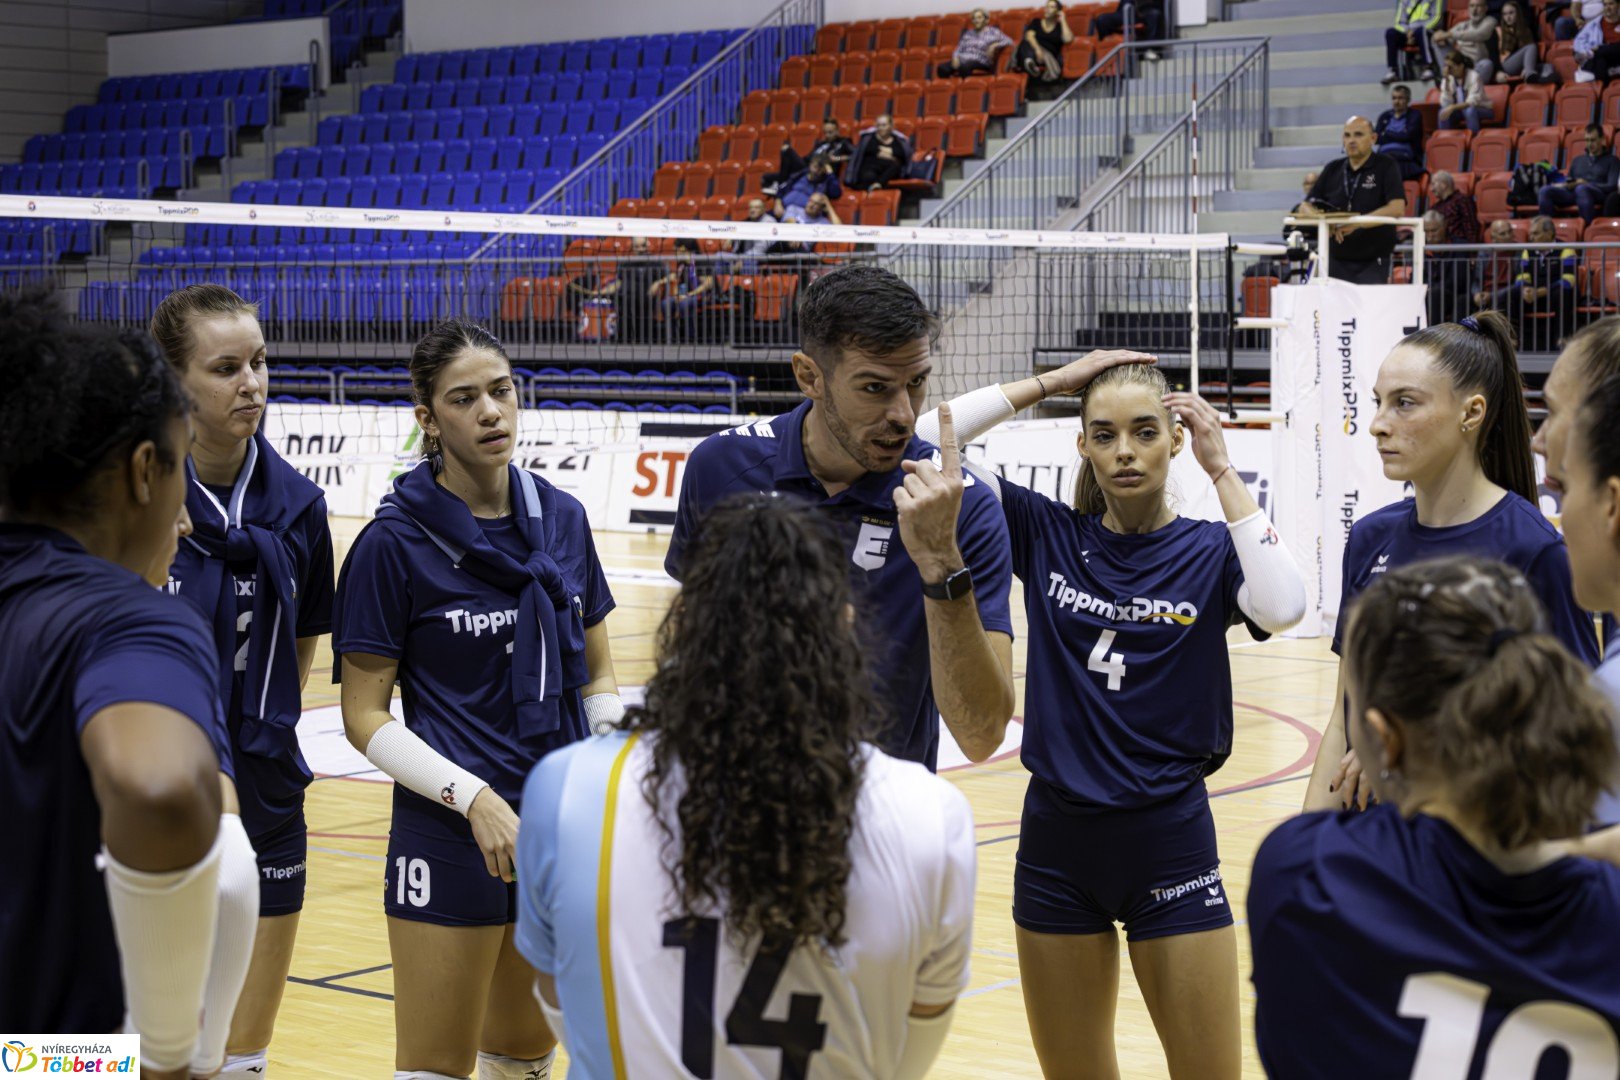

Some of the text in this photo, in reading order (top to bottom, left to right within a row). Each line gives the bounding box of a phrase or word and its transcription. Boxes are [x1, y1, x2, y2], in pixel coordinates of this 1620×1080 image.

[1338, 318, 1358, 436] TippmixPRO
[1046, 571, 1199, 626] TippmixPRO
[1087, 628, 1127, 692] 4
[396, 856, 431, 907] 19
[661, 916, 827, 1080] 14
